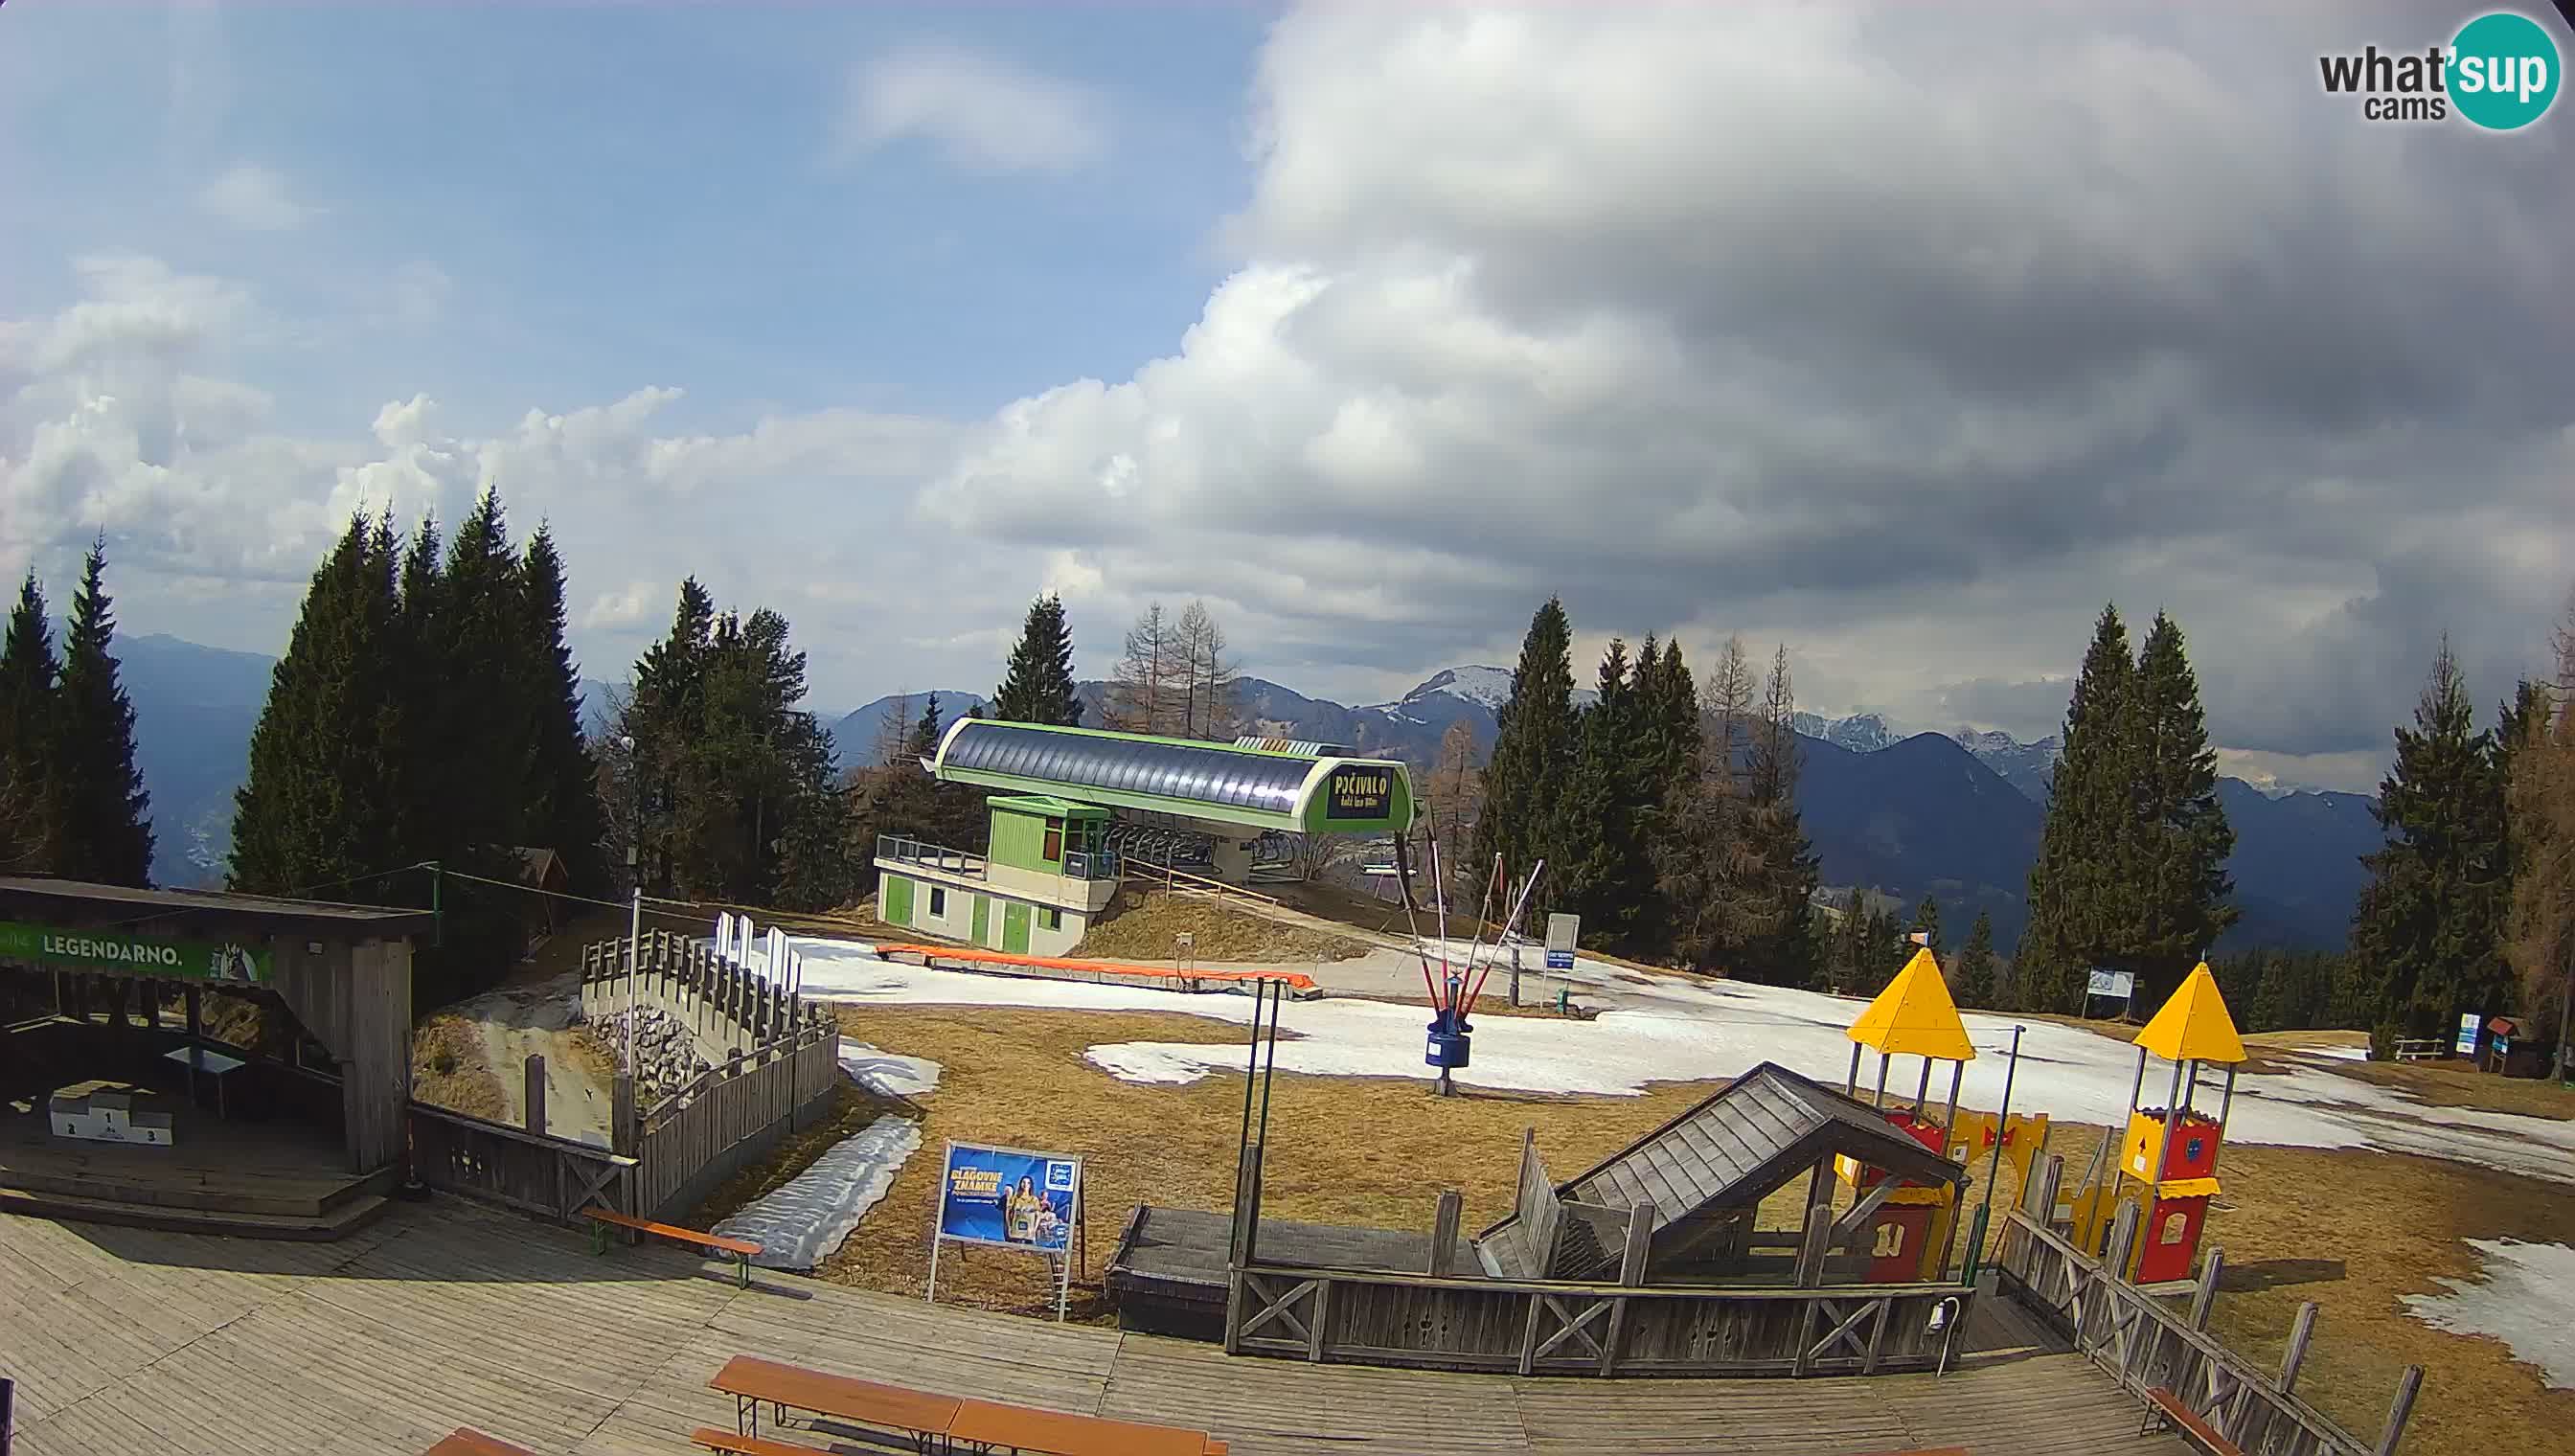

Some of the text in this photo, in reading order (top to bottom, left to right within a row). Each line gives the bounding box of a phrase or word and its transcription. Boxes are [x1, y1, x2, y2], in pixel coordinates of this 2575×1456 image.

[43, 934, 183, 967] LEGENDARNO.
[104, 1111, 112, 1124] 1
[147, 1130, 156, 1142] 3
